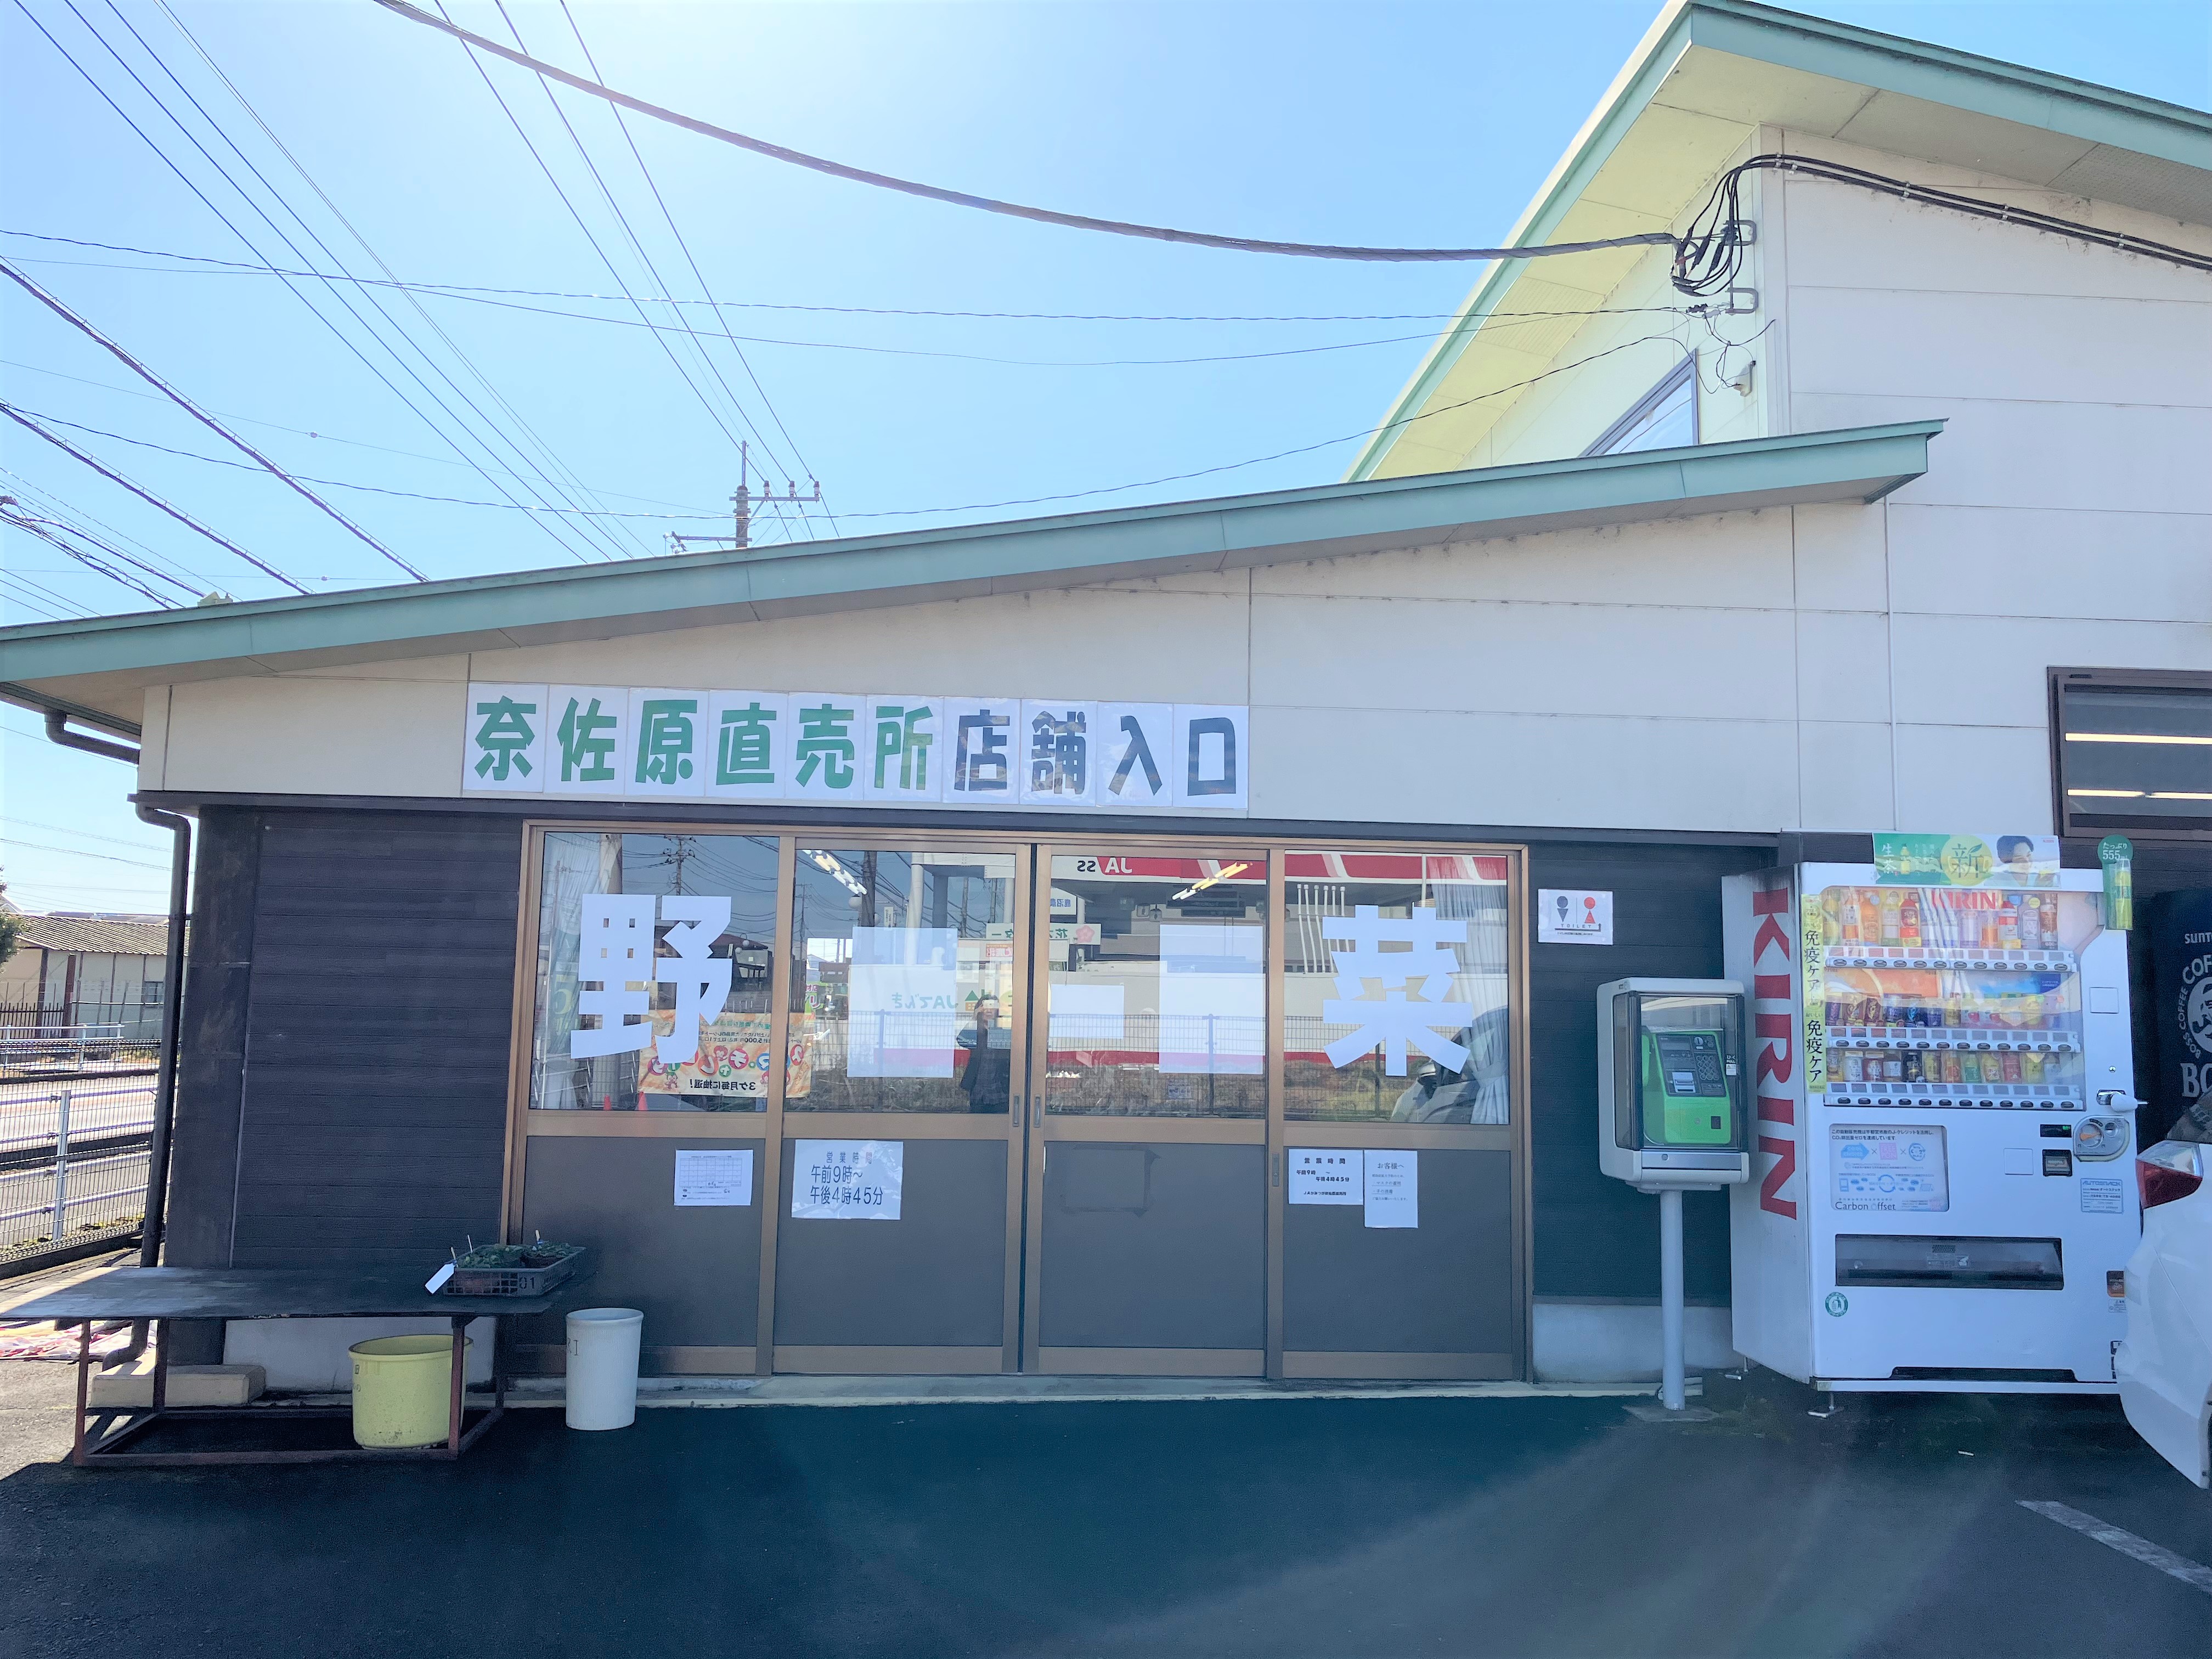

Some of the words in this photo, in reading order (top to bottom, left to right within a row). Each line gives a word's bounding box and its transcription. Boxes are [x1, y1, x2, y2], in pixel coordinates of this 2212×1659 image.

[474, 695, 1237, 797] 奈佐原直売所店舗入口
[1881, 843, 1899, 874] 生茶
[570, 893, 732, 1064] 野
[1322, 905, 1473, 1077] 菜
[1804, 929, 1821, 992] 免疫ケア
[2178, 987, 2189, 1030] COFFEE
[1752, 887, 1797, 1221] KIRIN
[1805, 1019, 1823, 1083] 免疫ケア
[826, 1151, 872, 1164] 営業時間
[810, 1186, 883, 1205] 午後4時45分
[1835, 1201, 1869, 1210] Carbon
